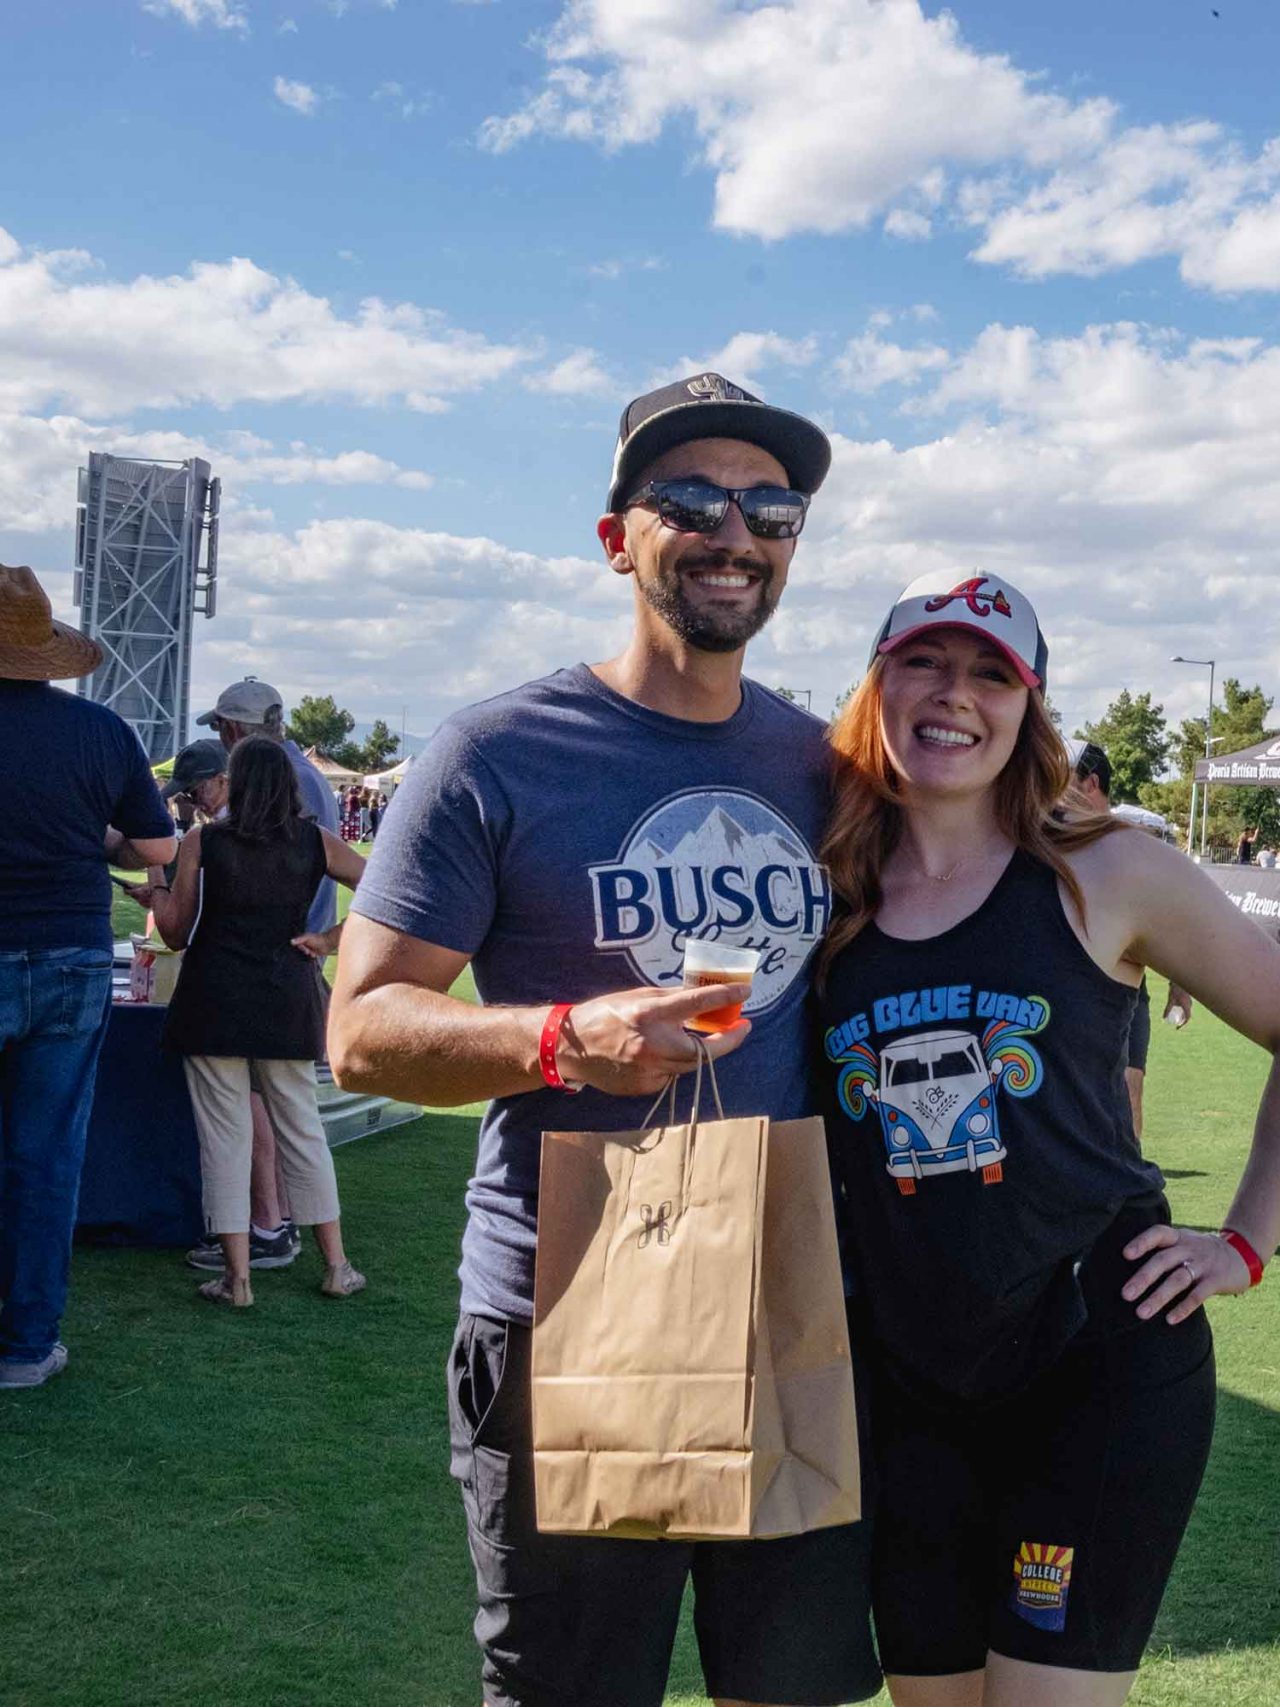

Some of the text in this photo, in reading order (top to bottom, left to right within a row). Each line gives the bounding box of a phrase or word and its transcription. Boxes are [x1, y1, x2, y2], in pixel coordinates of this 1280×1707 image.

[594, 865, 831, 943] BUSCH
[828, 985, 1044, 1057] BIG BLUE VAN
[1022, 1564, 1061, 1583] COLLEGE
